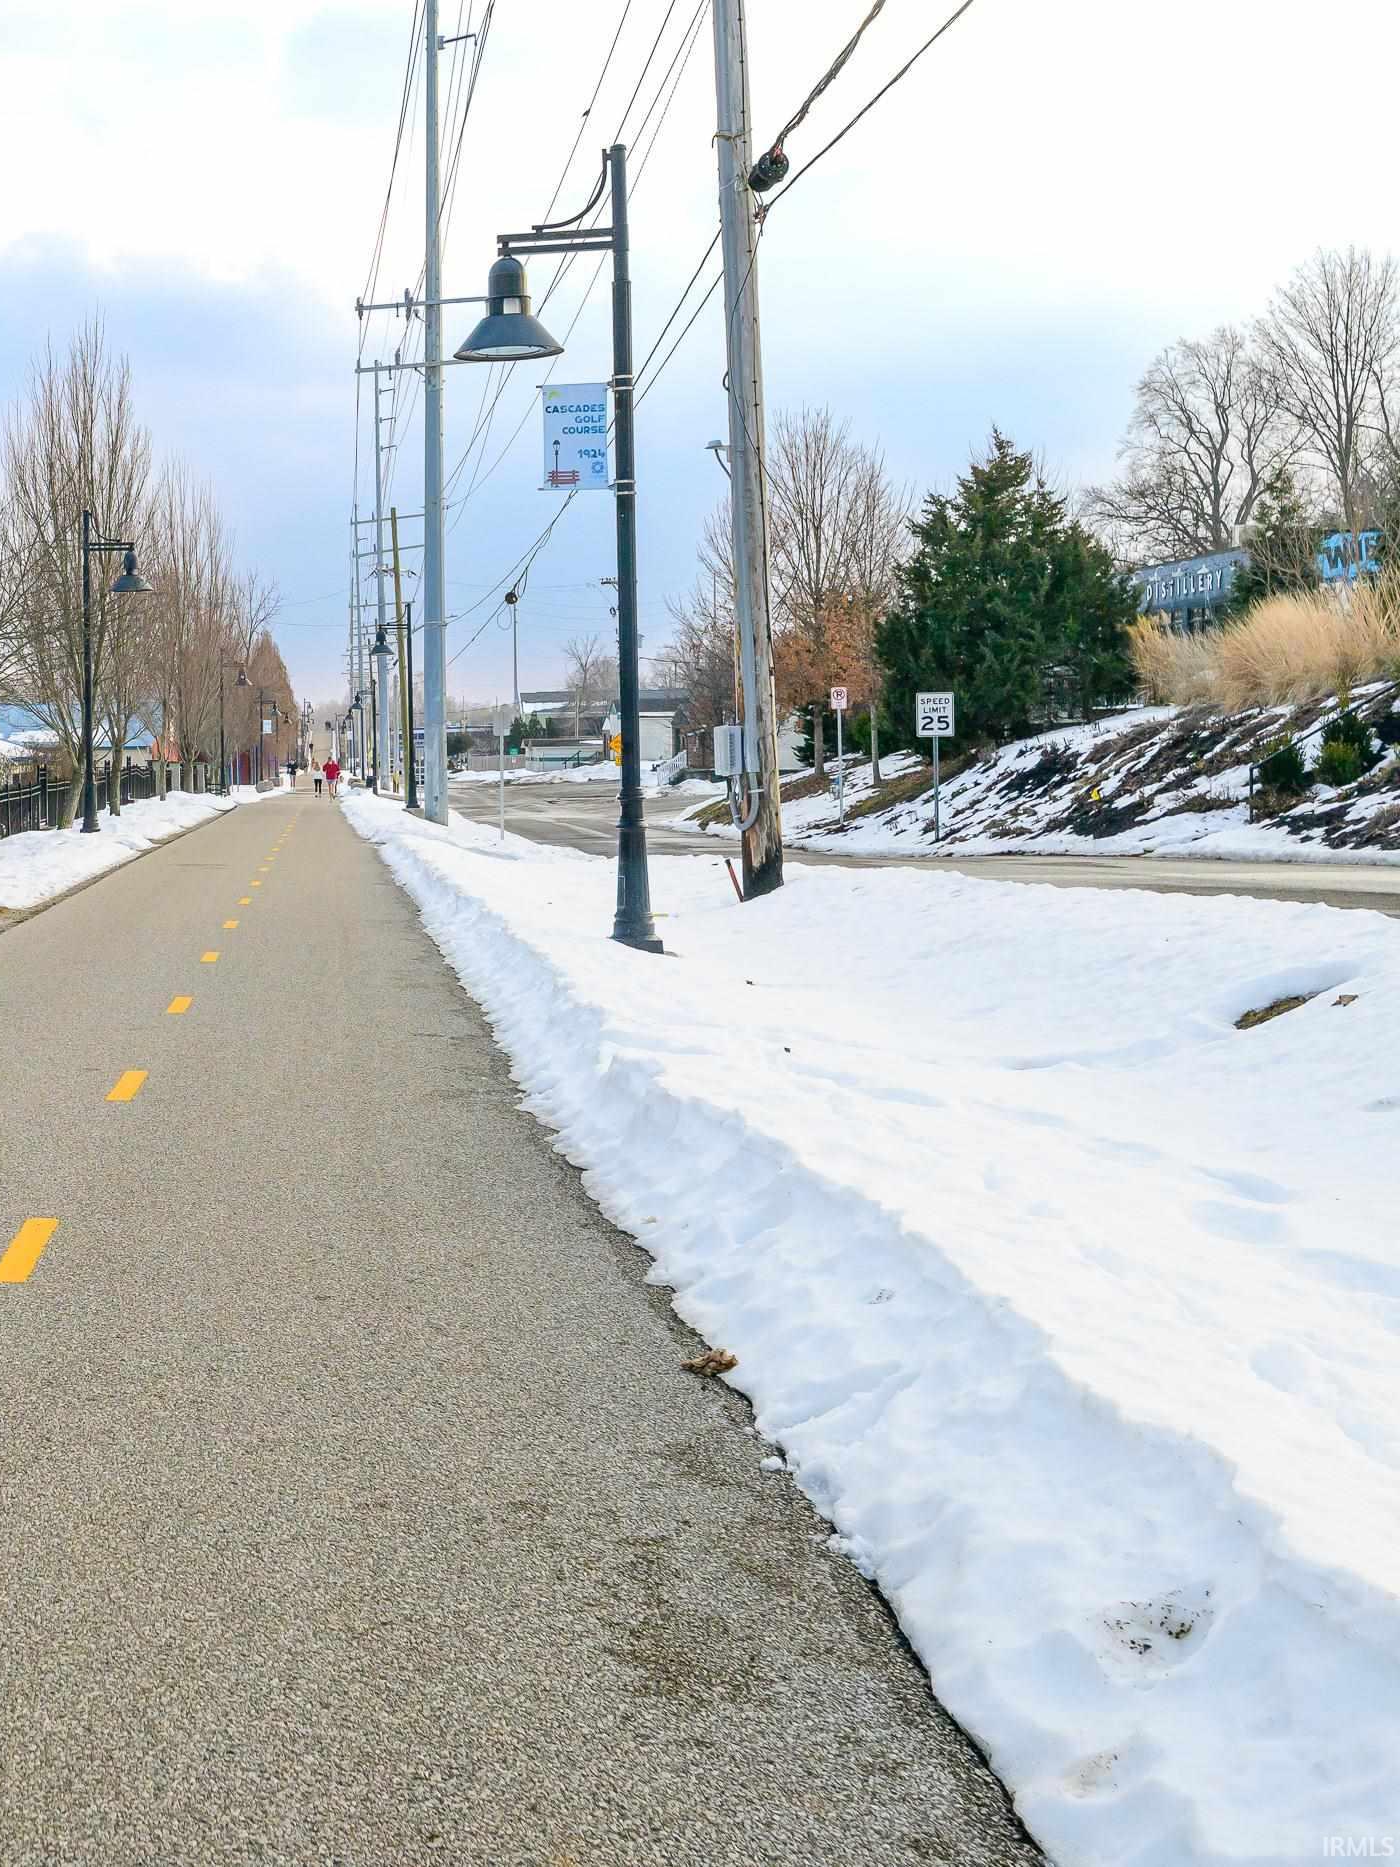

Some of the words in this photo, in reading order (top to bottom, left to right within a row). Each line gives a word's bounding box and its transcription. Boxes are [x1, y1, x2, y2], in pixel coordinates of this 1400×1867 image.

[545, 403, 606, 414] CASCADES
[574, 414, 606, 424] GOLF
[561, 425, 606, 435] COURSE
[577, 448, 606, 459] 1924
[1146, 569, 1223, 601] DISTILLERY
[920, 697, 951, 705] SPEED
[923, 706, 947, 714] LIMIT
[920, 715, 951, 731] 25
